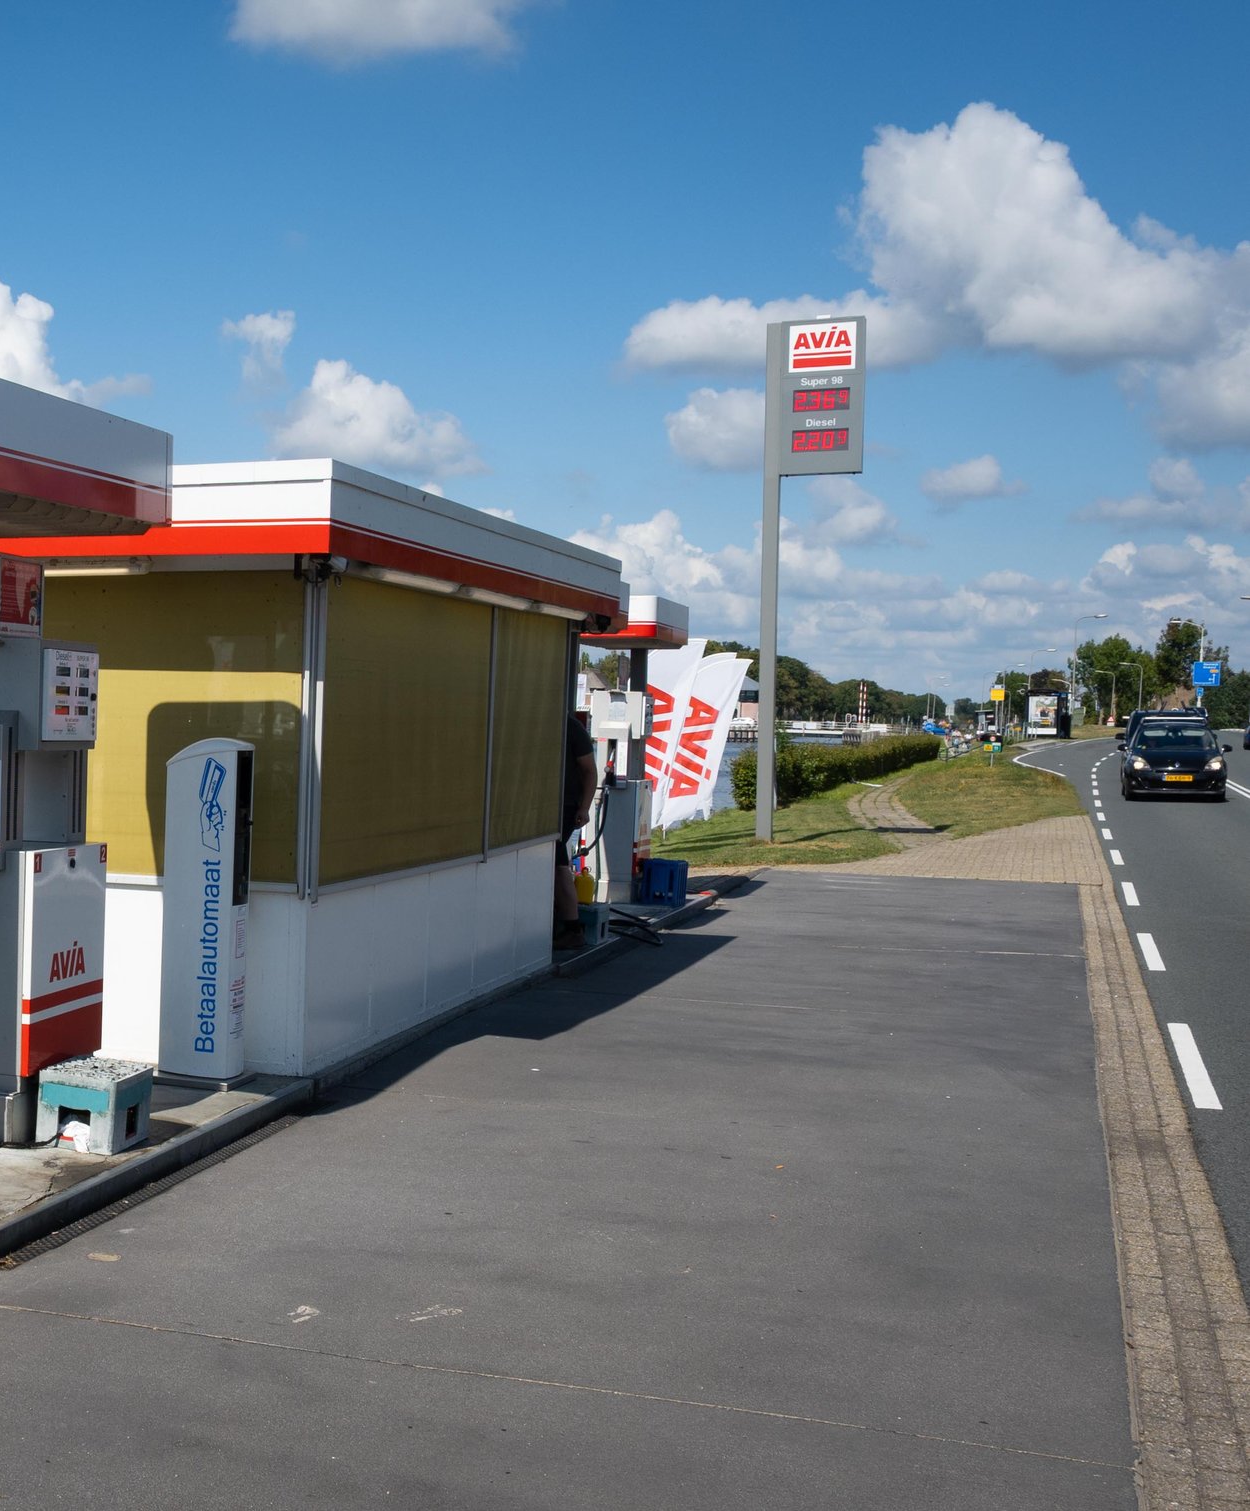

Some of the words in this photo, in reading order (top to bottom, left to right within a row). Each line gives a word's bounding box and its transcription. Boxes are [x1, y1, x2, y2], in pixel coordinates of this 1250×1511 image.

[800, 377, 828, 387] Super
[831, 376, 843, 385] 98
[805, 418, 836, 427] Diesel
[194, 859, 221, 1054] Betaalautomaat
